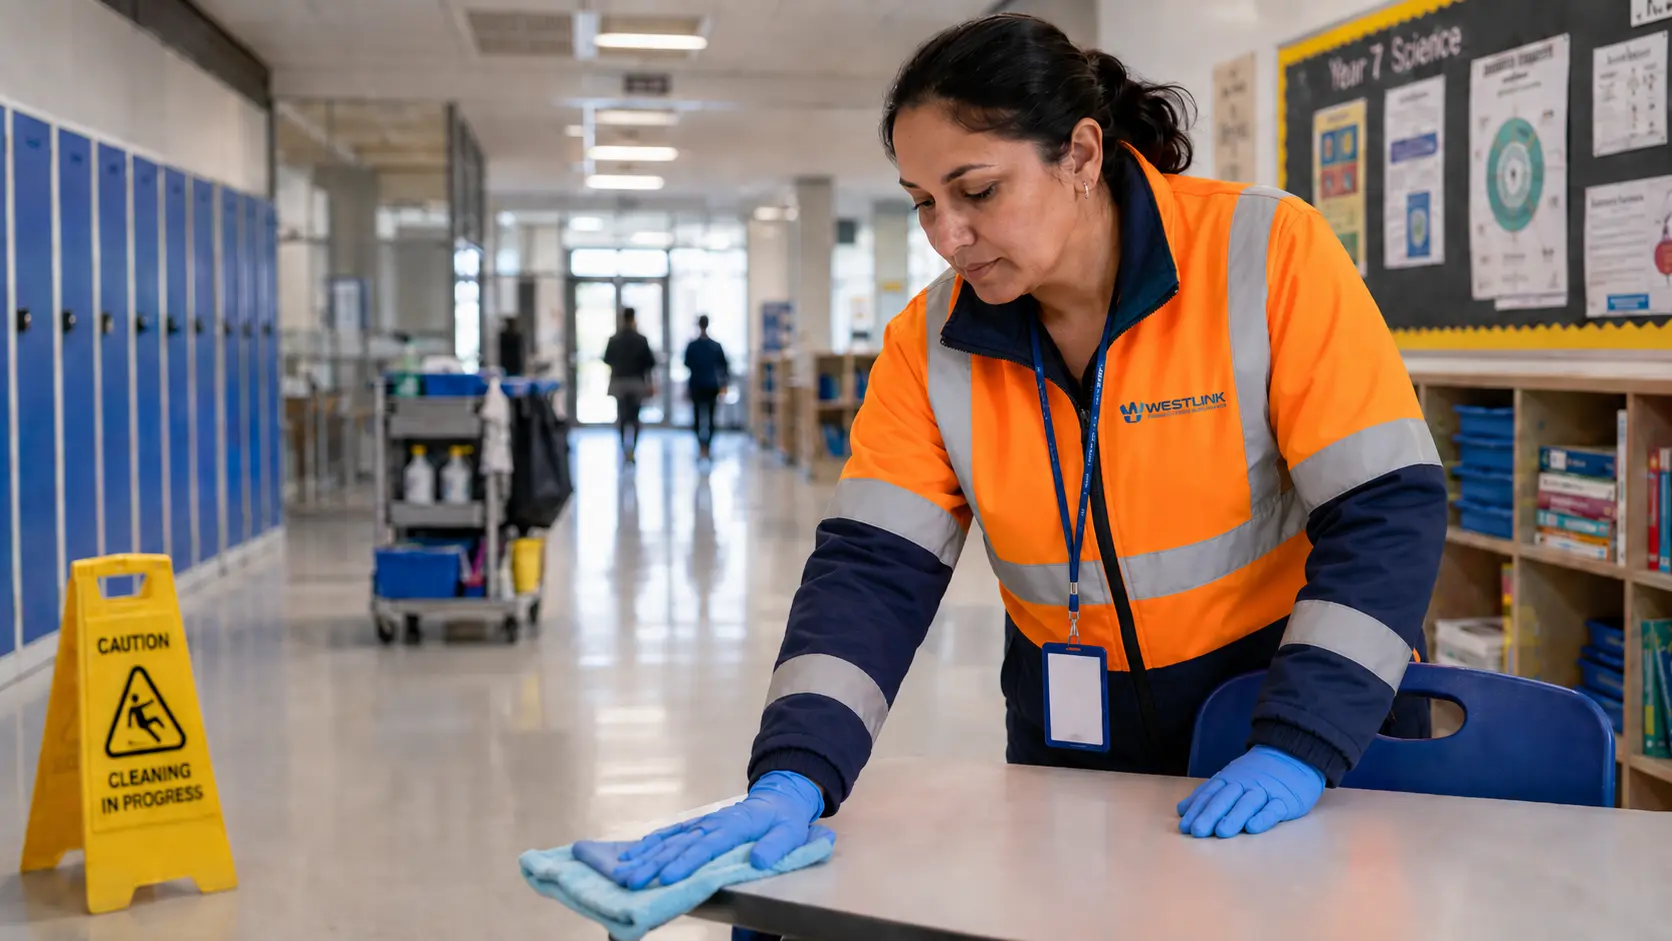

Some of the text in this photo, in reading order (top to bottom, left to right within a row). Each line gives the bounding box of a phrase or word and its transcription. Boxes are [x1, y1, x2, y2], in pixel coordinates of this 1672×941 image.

[1328, 56, 1368, 91] Year
[1369, 42, 1384, 81] 7
[1390, 26, 1462, 74] Science
[1145, 391, 1227, 414] WESTLINK
[97, 633, 170, 655] CAUTION
[108, 763, 192, 789] CLEANING
[101, 785, 204, 815] IN PROGRESS
